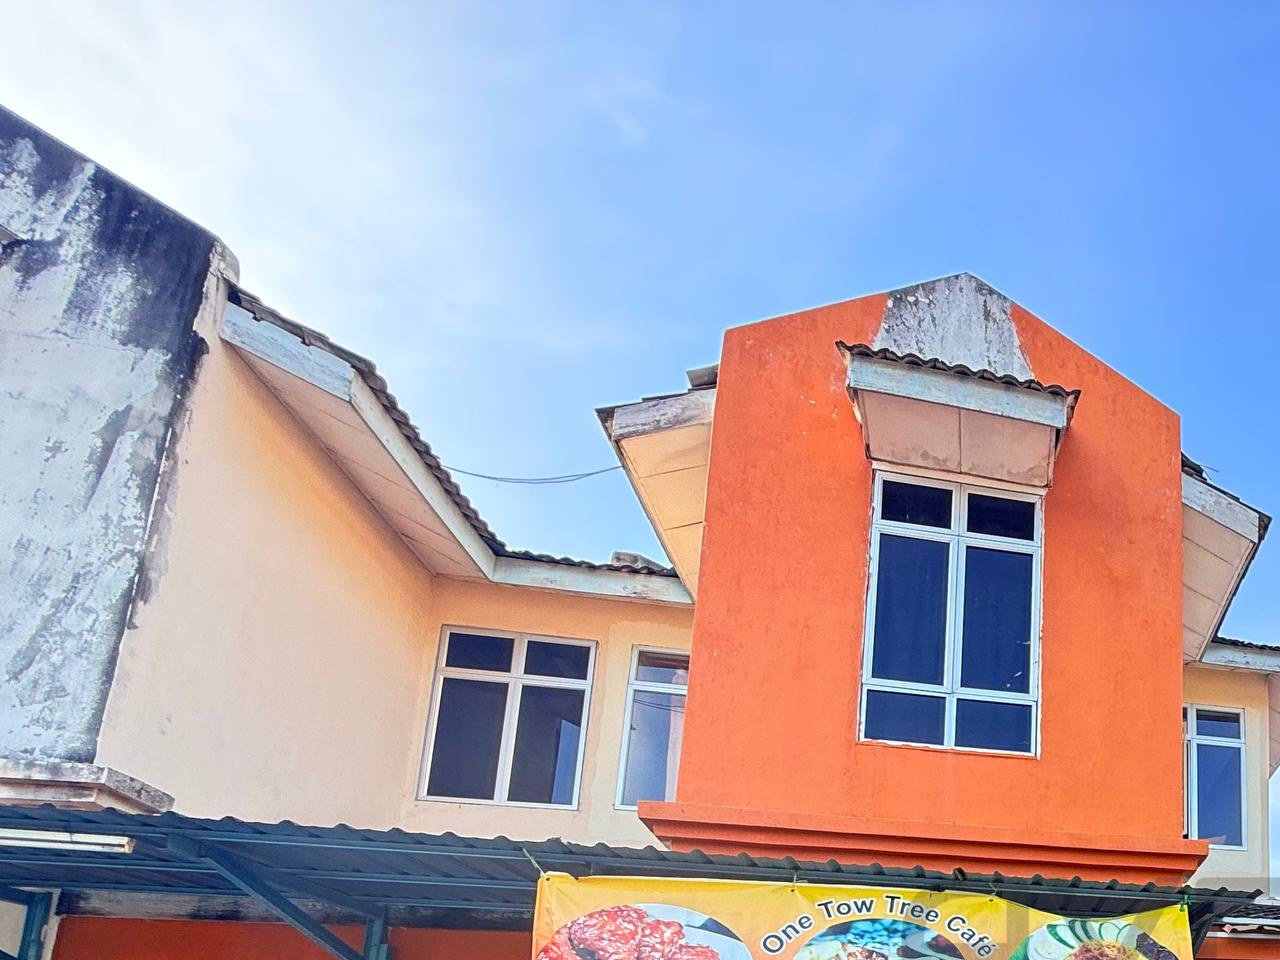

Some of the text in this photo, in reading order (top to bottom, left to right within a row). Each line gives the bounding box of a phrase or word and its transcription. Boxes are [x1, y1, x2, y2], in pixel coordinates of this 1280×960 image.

[762, 895, 998, 957] One Tow Tree Café
